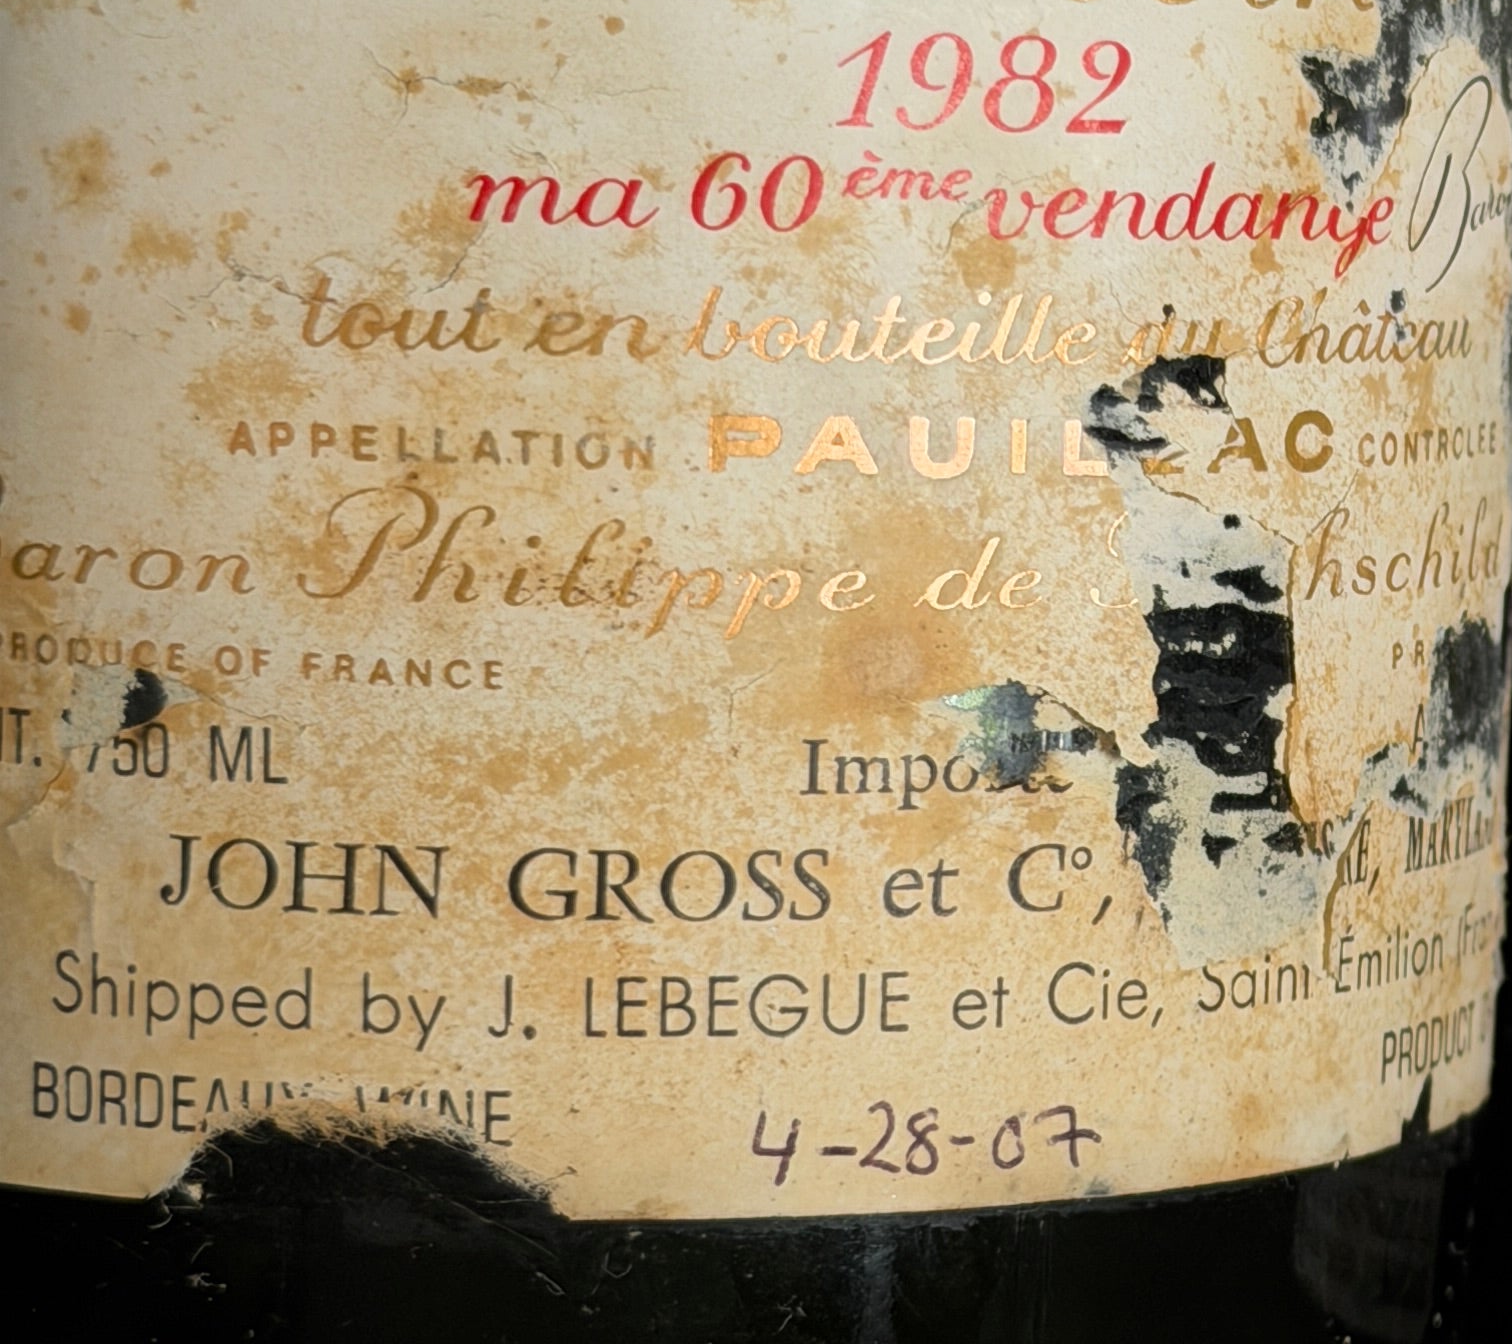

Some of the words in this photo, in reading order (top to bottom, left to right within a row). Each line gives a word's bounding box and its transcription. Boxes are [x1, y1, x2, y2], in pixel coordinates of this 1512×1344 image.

[833, 30, 1133, 135] 1982
[465, 172, 661, 229] ma
[301, 272, 503, 354] tout
[522, 311, 662, 362] en
[685, 285, 1099, 366] bouteille
[227, 420, 658, 472] APPELLATION
[706, 410, 1334, 480] PAUILAC
[12, 536, 257, 595] aron
[296, 483, 877, 642] Philippe
[912, 536, 1044, 611] de
[0, 630, 187, 673] RODUCE
[214, 644, 273, 678] OF
[302, 652, 505, 690] FRANCE
[208, 723, 289, 785] ML
[159, 833, 450, 920] JOHN
[506, 845, 831, 924] GROSS
[882, 857, 960, 918] et
[51, 949, 313, 1040] Shipped
[362, 971, 447, 1053] by
[488, 974, 538, 1041] J.
[584, 972, 910, 1039] LEBEGUE
[951, 976, 1011, 1031] et
[1047, 961, 1165, 1029] Cie,
[1381, 998, 1477, 1086] PRODUCT
[751, 1100, 1103, 1187] 4-28-07
